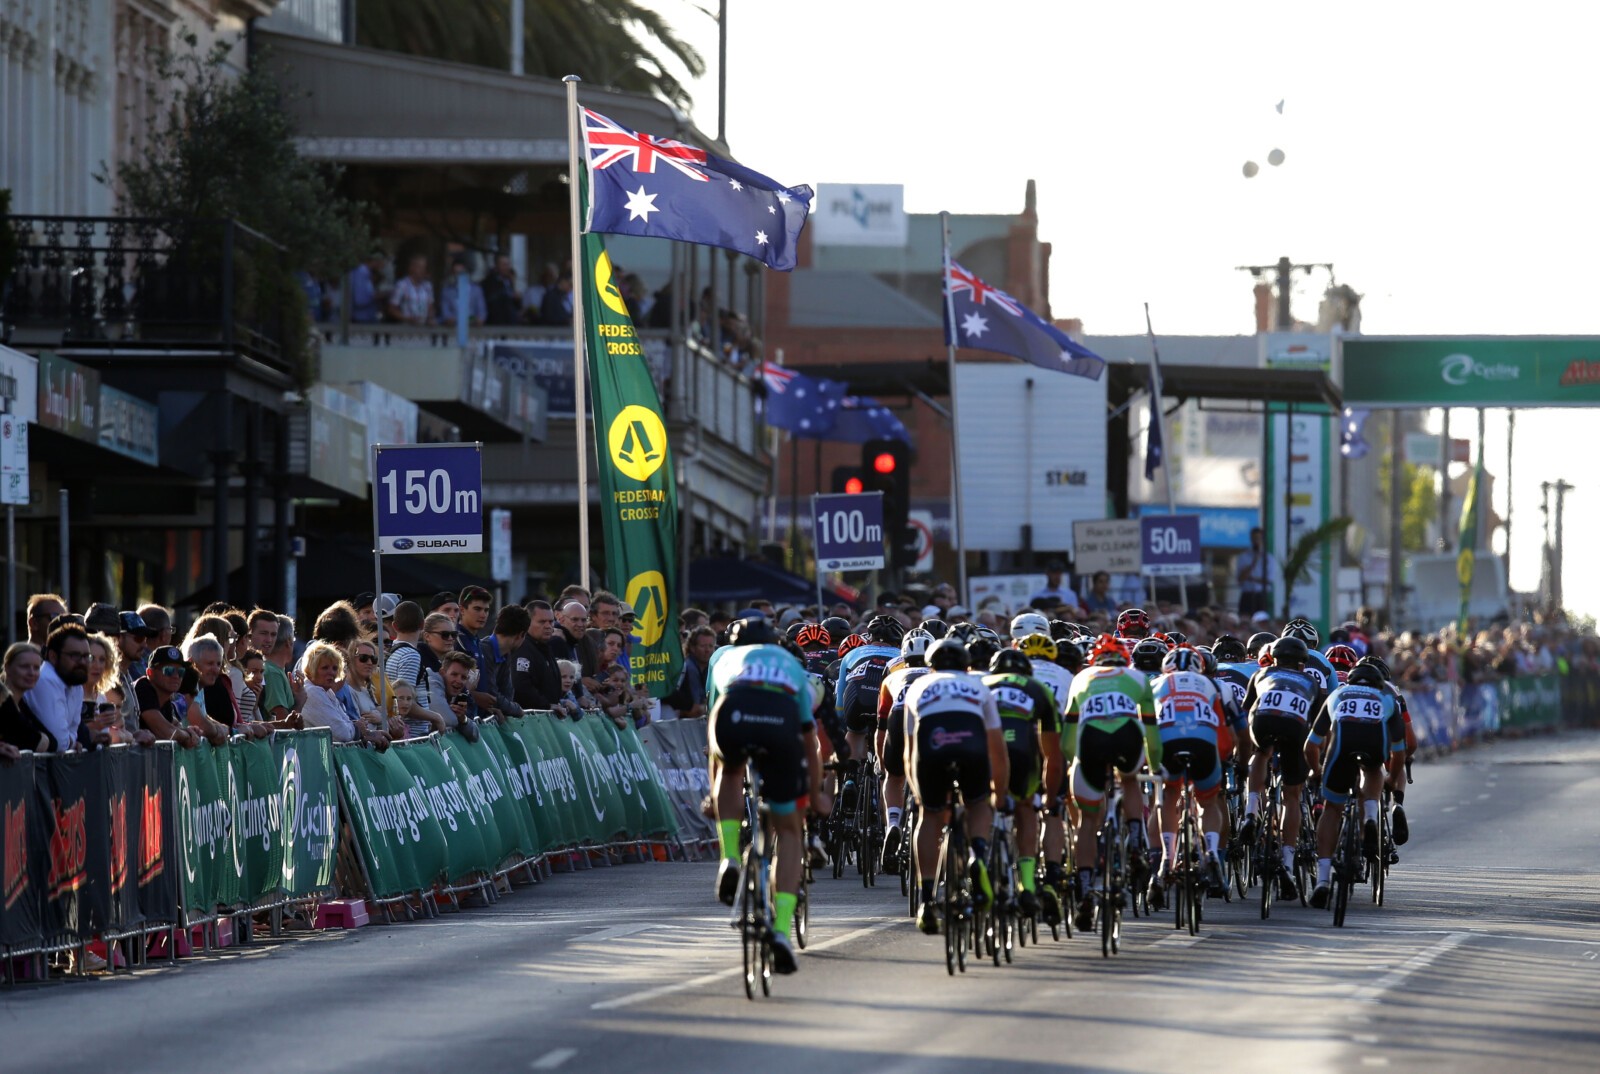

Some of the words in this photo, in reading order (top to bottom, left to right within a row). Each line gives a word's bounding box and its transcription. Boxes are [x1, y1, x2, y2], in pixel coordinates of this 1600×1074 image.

[381, 468, 478, 515] 150m
[818, 510, 882, 545] 100m
[416, 540, 468, 548] SUBARU
[1150, 527, 1192, 554] 50m
[1086, 697, 1104, 714] 45
[1264, 692, 1282, 707] 40
[1290, 696, 1307, 715] 40
[1340, 700, 1357, 714] 49
[1363, 701, 1380, 716] 49
